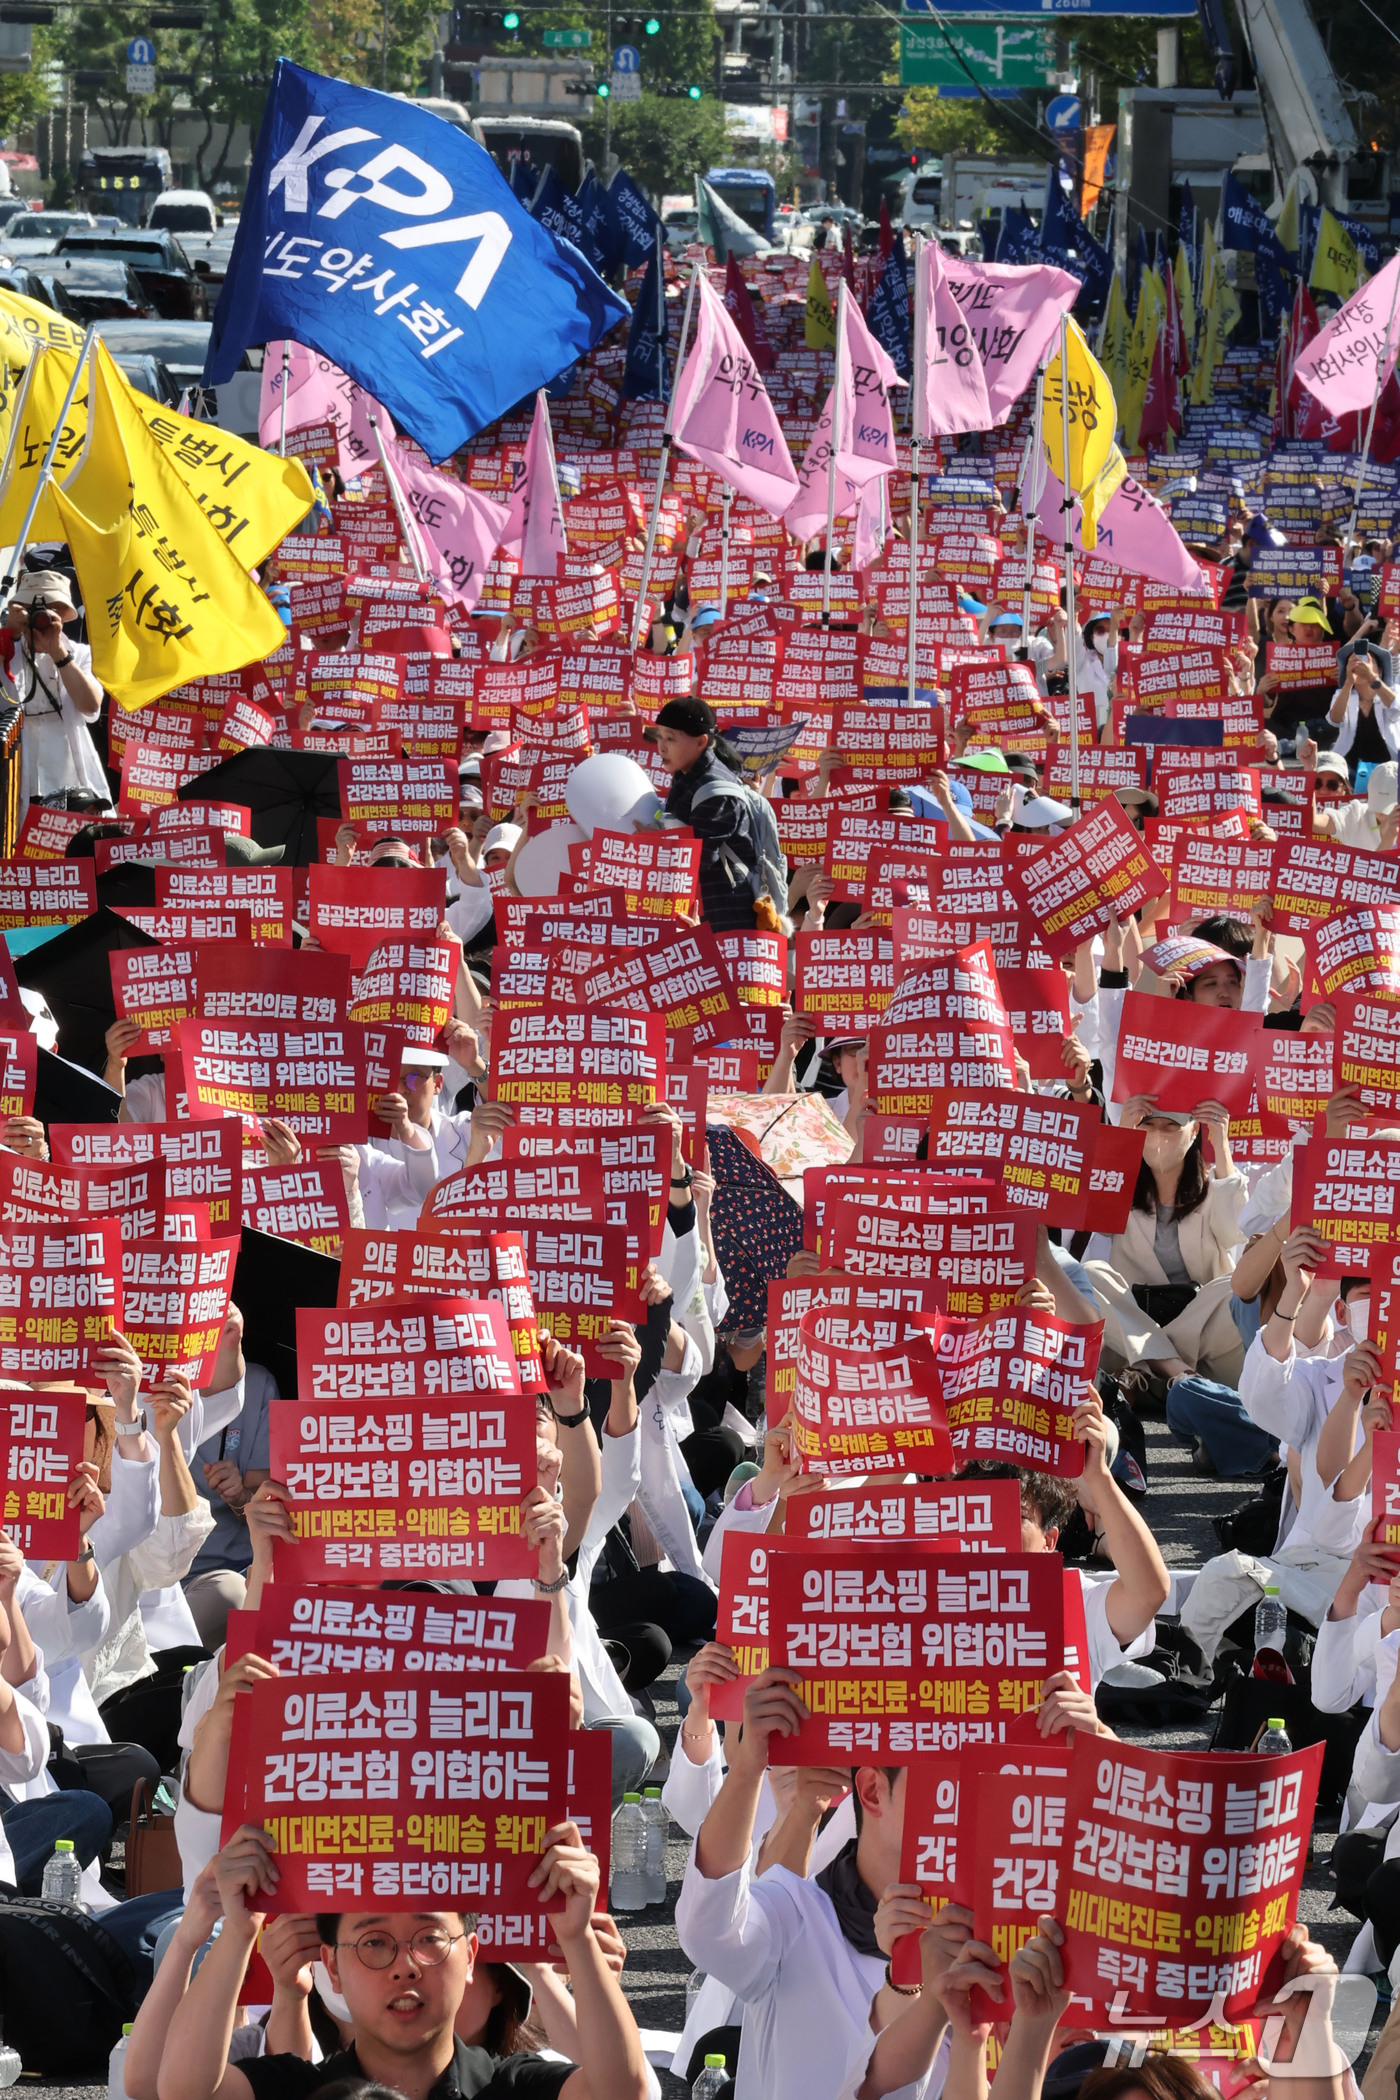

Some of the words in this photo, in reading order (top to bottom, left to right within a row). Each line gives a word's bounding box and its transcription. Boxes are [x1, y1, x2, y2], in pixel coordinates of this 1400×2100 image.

[318, 653, 361, 666] 의료쇼핑
[364, 654, 396, 669] 늘리고
[1140, 657, 1180, 677] 의료쇼핑
[1182, 651, 1213, 667] 늘리고
[1274, 646, 1306, 658] 의료쇼핑
[1309, 646, 1333, 656] 늘리고
[484, 671, 527, 687] 의료쇼핑
[529, 666, 555, 681] 늘리고
[968, 671, 1007, 689] 의료쇼핑
[843, 712, 891, 730] 의료쇼핑
[894, 713, 931, 730] 늘리고
[1176, 703, 1218, 718] 의료쇼핑
[1221, 701, 1253, 715] 늘리고
[352, 764, 404, 781] 의료쇼핑
[406, 764, 446, 781] 늘리고
[852, 768, 873, 780] 즉각
[876, 766, 922, 780] 중단하라!
[1168, 773, 1216, 796] 의료쇼핑
[1219, 771, 1253, 791] 늘리고
[347, 784, 399, 801] 건강보험
[402, 784, 453, 800] 위협하는
[349, 804, 431, 820] 비대면진료·약배송
[434, 804, 453, 818] 확대
[367, 820, 388, 831] 즉각
[391, 819, 438, 832] 중단하라!
[601, 837, 653, 867] 의료쇼핑
[656, 842, 693, 868] 늘리고
[1021, 839, 1083, 894] 의료쇼핑
[1074, 810, 1118, 848] 늘리고
[1288, 845, 1351, 874] 의료쇼핑
[1353, 855, 1399, 884] 늘리고
[35, 865, 80, 886] 늘리고
[1028, 867, 1092, 918] 건강보험
[1085, 831, 1138, 878] 위협하는
[1276, 867, 1338, 898] 건강보험
[30, 889, 89, 910] 위협하는
[317, 903, 405, 929] 공공보건의료
[409, 904, 438, 930] 강화
[810, 937, 874, 962] 의료쇼핑
[584, 954, 647, 1003] 의료쇼핑
[646, 937, 703, 975] 늘리고
[803, 965, 866, 989] 건강보험
[200, 1031, 279, 1056] 의료쇼핑
[283, 1032, 345, 1056] 늘리고
[508, 1015, 585, 1044] 의료쇼핑
[591, 1015, 648, 1046] 늘리고
[885, 1032, 953, 1059] 의료쇼핑
[958, 1032, 1004, 1059] 늘리고
[498, 1048, 574, 1074] 건강보험
[580, 1049, 657, 1079] 위협하는
[1122, 1034, 1209, 1072] 공공보건의료
[1213, 1049, 1248, 1074] 강화
[194, 1056, 270, 1087] 건강보험
[276, 1065, 355, 1087] 위협하는
[876, 1064, 945, 1088] 건강보험
[951, 1063, 1013, 1089] 위협하는
[1264, 1066, 1332, 1092] 건강보험
[198, 1085, 320, 1114] 비대면진료·약배송
[325, 1094, 355, 1114] 확대
[497, 1082, 622, 1104] 비대면진료·약배송
[627, 1082, 656, 1105] 확대
[946, 1101, 1018, 1130] 의료쇼핑
[1022, 1107, 1080, 1141] 늘리고
[71, 1134, 155, 1163] 의료쇼핑
[161, 1130, 221, 1160] 늘리고
[11, 1166, 80, 1209] 의료쇼핑
[87, 1170, 148, 1212] 늘리고
[261, 1171, 324, 1202] 늘리고
[434, 1169, 509, 1211] 의료쇼핑
[514, 1165, 581, 1199] 늘리고
[1089, 1169, 1124, 1193] 강화
[1312, 1183, 1395, 1214] 건강보험
[257, 1204, 339, 1234] 위협하는
[42, 1233, 105, 1267] 늘리고
[1334, 1245, 1370, 1267] 즉각
[122, 1252, 195, 1285] 의료쇼핑
[29, 1274, 115, 1308] 위협하는
[324, 1317, 426, 1356] 의료쇼핑
[432, 1313, 497, 1350] 늘리고
[936, 1318, 1016, 1364] 의료쇼핑
[1024, 1320, 1086, 1368] 늘리고
[1, 1348, 88, 1370] 중단하라!
[836, 1356, 913, 1391] 늘리고
[1007, 1357, 1092, 1407] 위협하는
[828, 1395, 931, 1426] 위협하는
[300, 1414, 412, 1454] 의료쇼핑
[422, 1411, 506, 1450] 늘리고
[975, 1427, 1060, 1465] 중단하라!
[286, 1460, 399, 1500] 건강보험
[409, 1458, 521, 1497] 위협하는
[477, 1506, 520, 1535] 확대
[807, 1498, 906, 1538] 의료쇼핑
[914, 1495, 993, 1534] 늘리고
[325, 1543, 372, 1567] 즉각
[379, 1541, 484, 1568] 중단하라!
[801, 1570, 927, 1613] 의료쇼핑
[936, 1570, 1030, 1613] 늘리고
[290, 1598, 415, 1641] 의료쇼핑
[425, 1607, 516, 1651] 늘리고
[786, 1623, 911, 1667] 건강보험
[921, 1623, 1047, 1667] 위협하는
[282, 1690, 417, 1741] 의료쇼핑
[428, 1691, 534, 1740] 늘리고
[828, 1722, 881, 1751] 즉각
[264, 1751, 399, 1803] 건강보험
[411, 1751, 550, 1800] 위협하는
[1093, 1758, 1212, 1835] 의료쇼핑
[1224, 1770, 1302, 1833] 늘리고
[496, 1814, 546, 1854] 확대
[1071, 1820, 1190, 1898] 건강보험
[1203, 1833, 1301, 1899] 위협하는
[307, 1863, 364, 1895] 즉각
[372, 1863, 502, 1896] 중단하라!
[1066, 1889, 1260, 1957] 비대면진료·약배송
[1262, 1893, 1289, 1937] 확대
[1097, 1947, 1149, 1992] 즉각
[1155, 1951, 1261, 2000] 중단하라!
